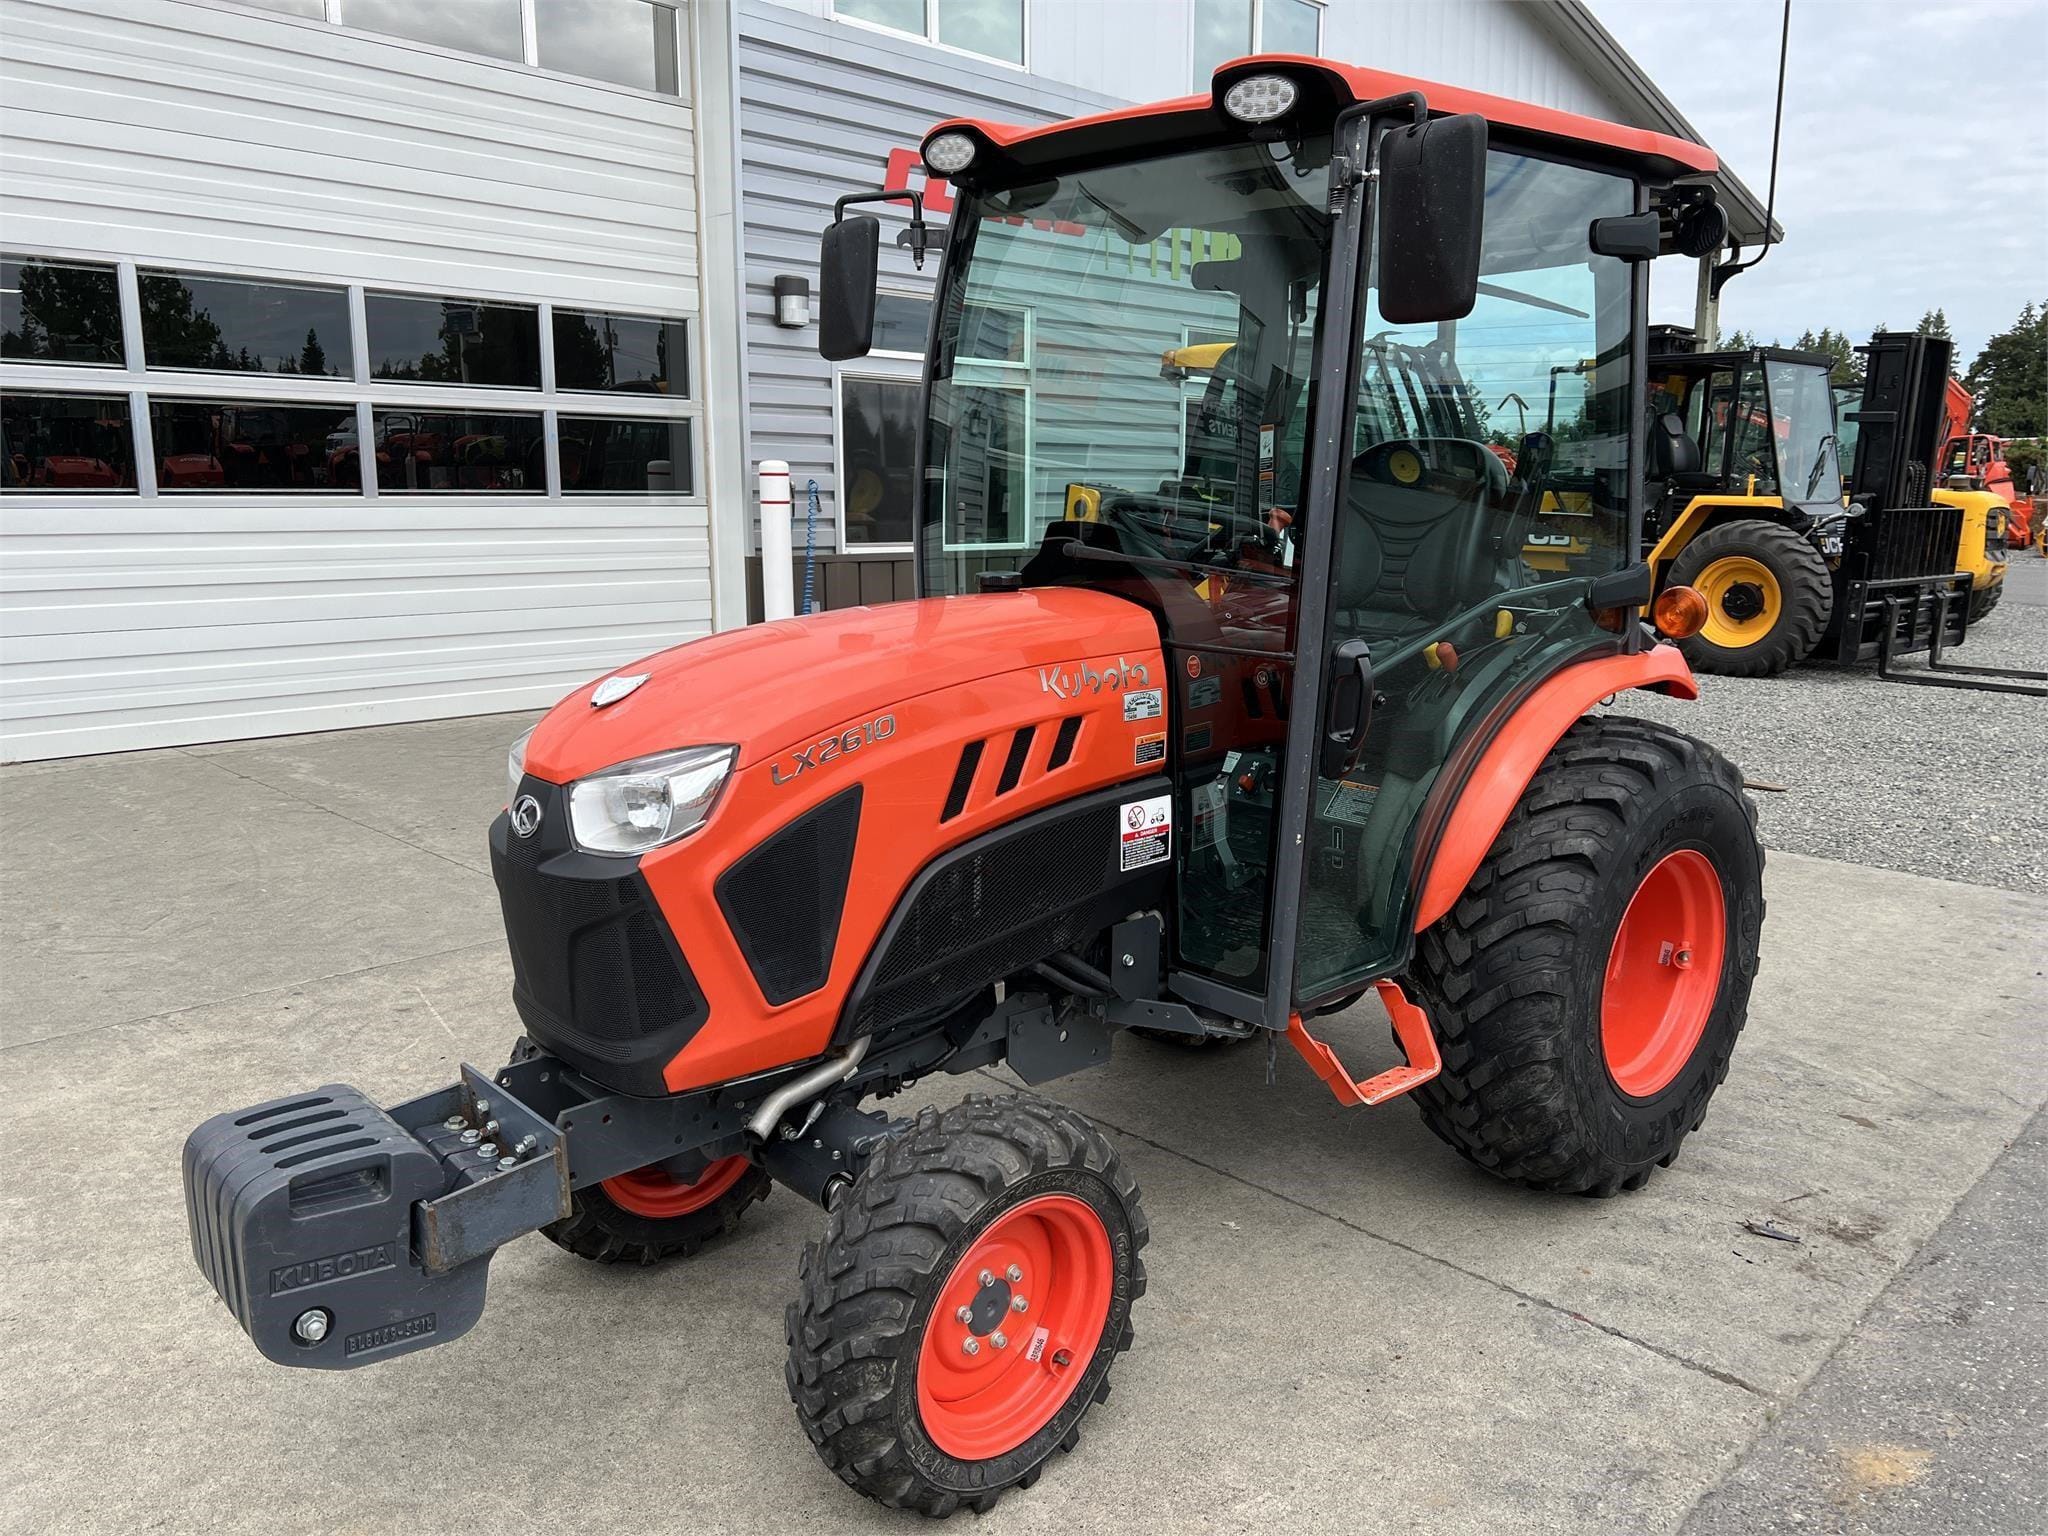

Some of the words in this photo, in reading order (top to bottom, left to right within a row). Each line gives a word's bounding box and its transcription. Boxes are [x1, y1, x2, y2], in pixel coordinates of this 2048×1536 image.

[1039, 657, 1149, 699] Kubota
[771, 714, 897, 786] LX2610
[273, 1244, 393, 1292] KUBOTA
